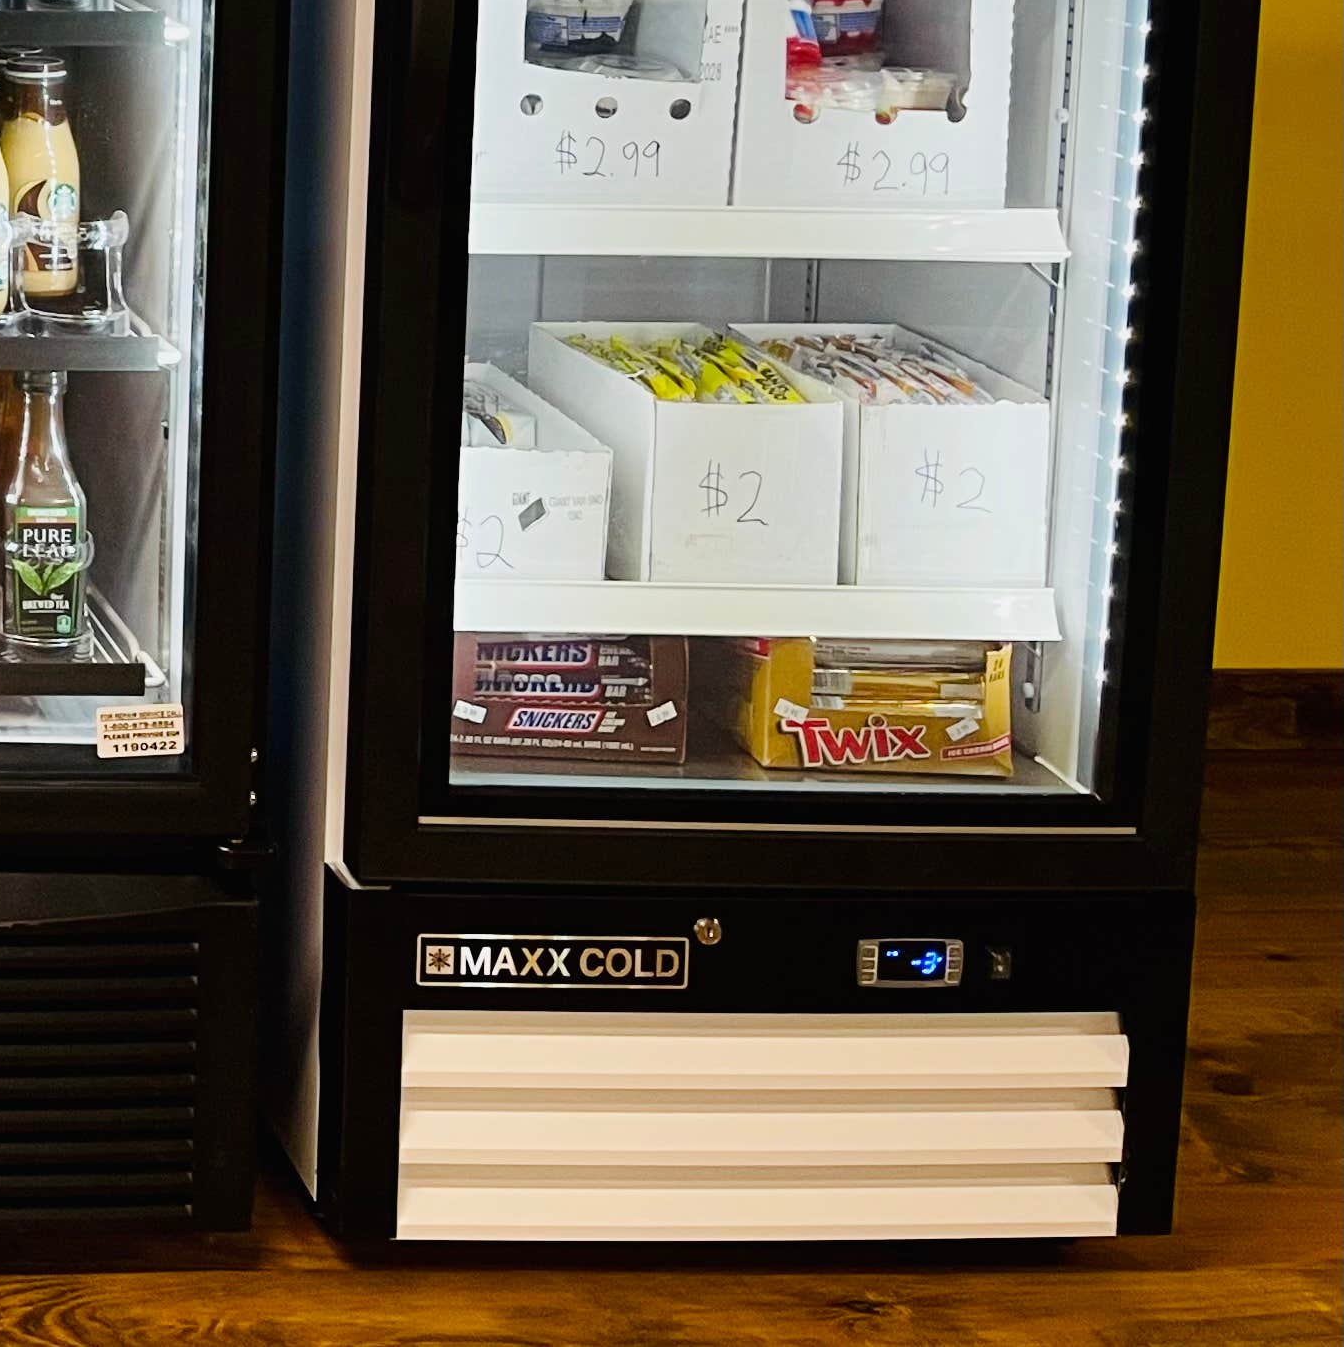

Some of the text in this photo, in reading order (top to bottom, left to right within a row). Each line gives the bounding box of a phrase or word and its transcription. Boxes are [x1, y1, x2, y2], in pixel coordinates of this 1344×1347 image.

[555, 129, 661, 178] $2.99
[836, 141, 949, 196] $2.99
[698, 459, 769, 526] $2
[914, 444, 992, 514] $2
[22, 528, 72, 543] PURE
[513, 710, 597, 730] SNICKERS
[112, 740, 177, 753] 1190422
[460, 946, 680, 978] MAXX COLD
